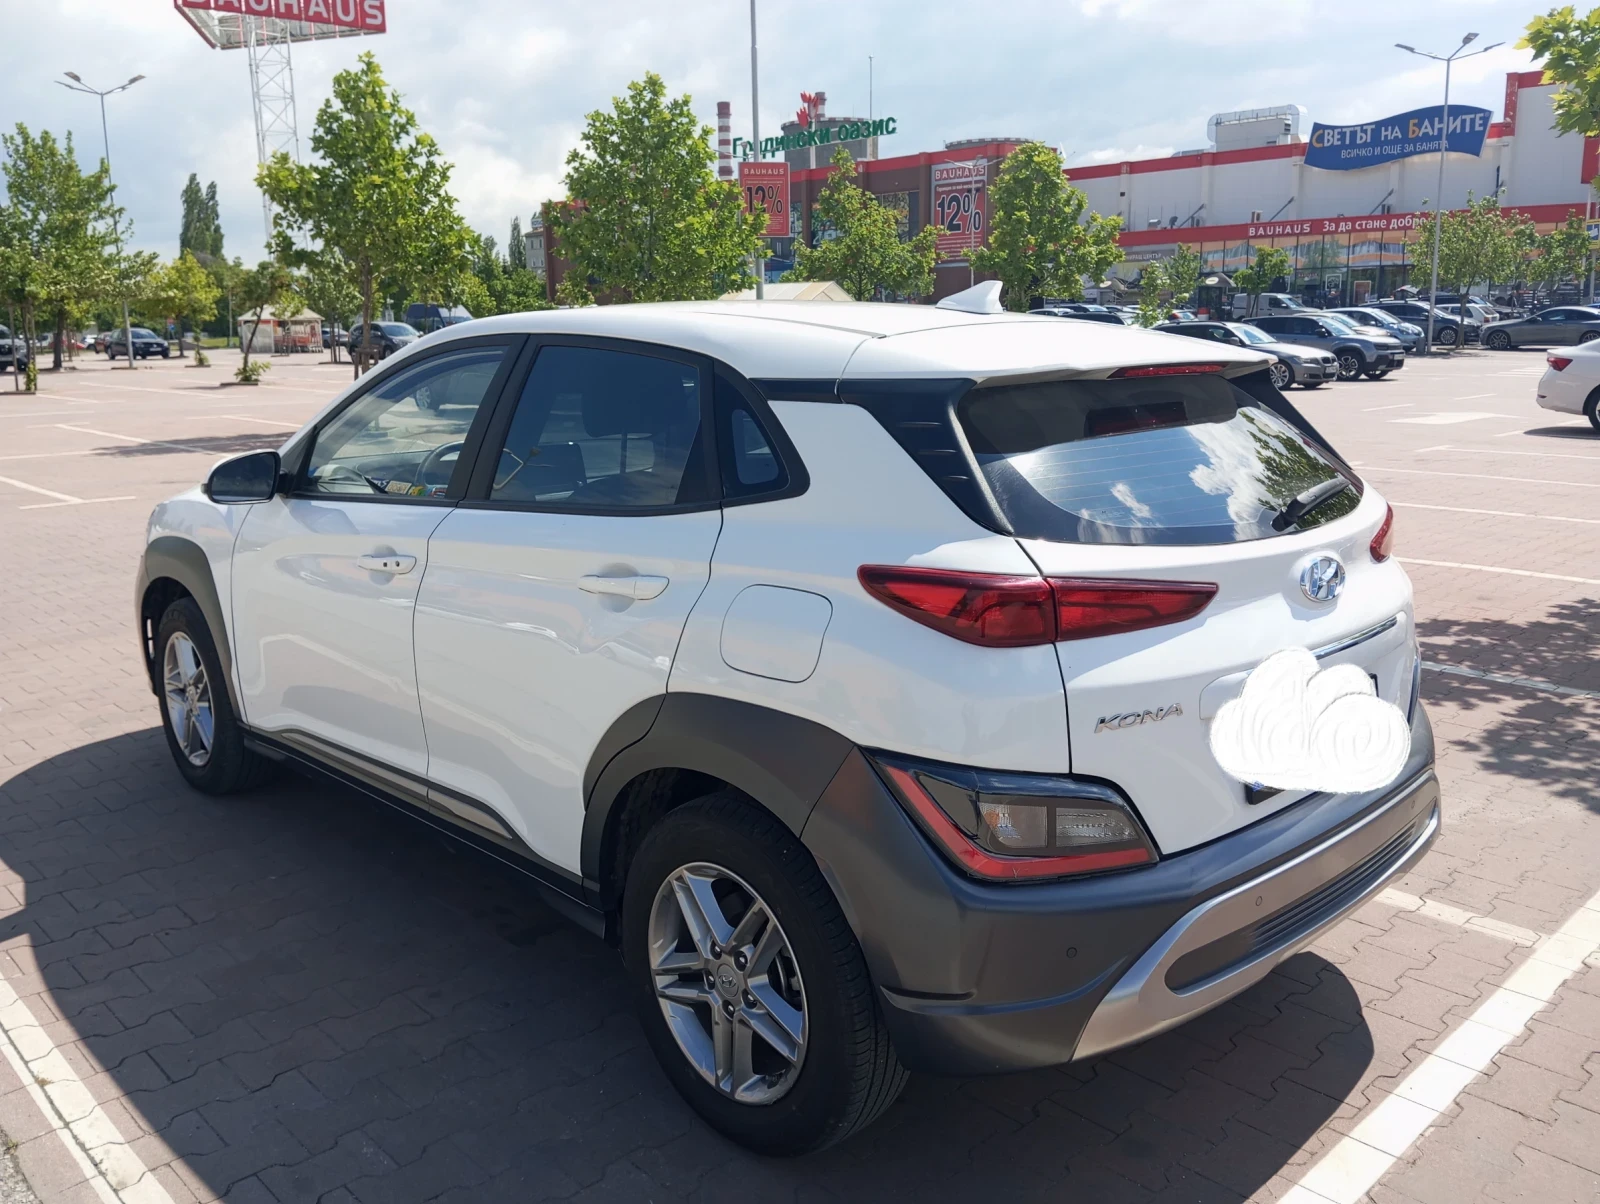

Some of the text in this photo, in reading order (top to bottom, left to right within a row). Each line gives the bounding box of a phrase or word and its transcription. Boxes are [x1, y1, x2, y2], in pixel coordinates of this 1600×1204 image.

[188, 0, 382, 25] HAUS
[732, 117, 897, 161] Грдински оазис
[1312, 113, 1484, 148] СВЕТЪТ НА БАНИТЕ
[1341, 140, 1449, 159] ВСИЧКО И ОЩЕ ЗА БАНЯТА
[935, 165, 985, 180] BAUHAUS
[746, 185, 783, 214] 12%
[937, 193, 982, 233] 12%
[1249, 223, 1311, 237] BAUHAUS
[1323, 220, 1336, 232] За
[1338, 221, 1352, 233] да
[1355, 217, 1387, 230] стане
[1094, 703, 1183, 734] KONA
